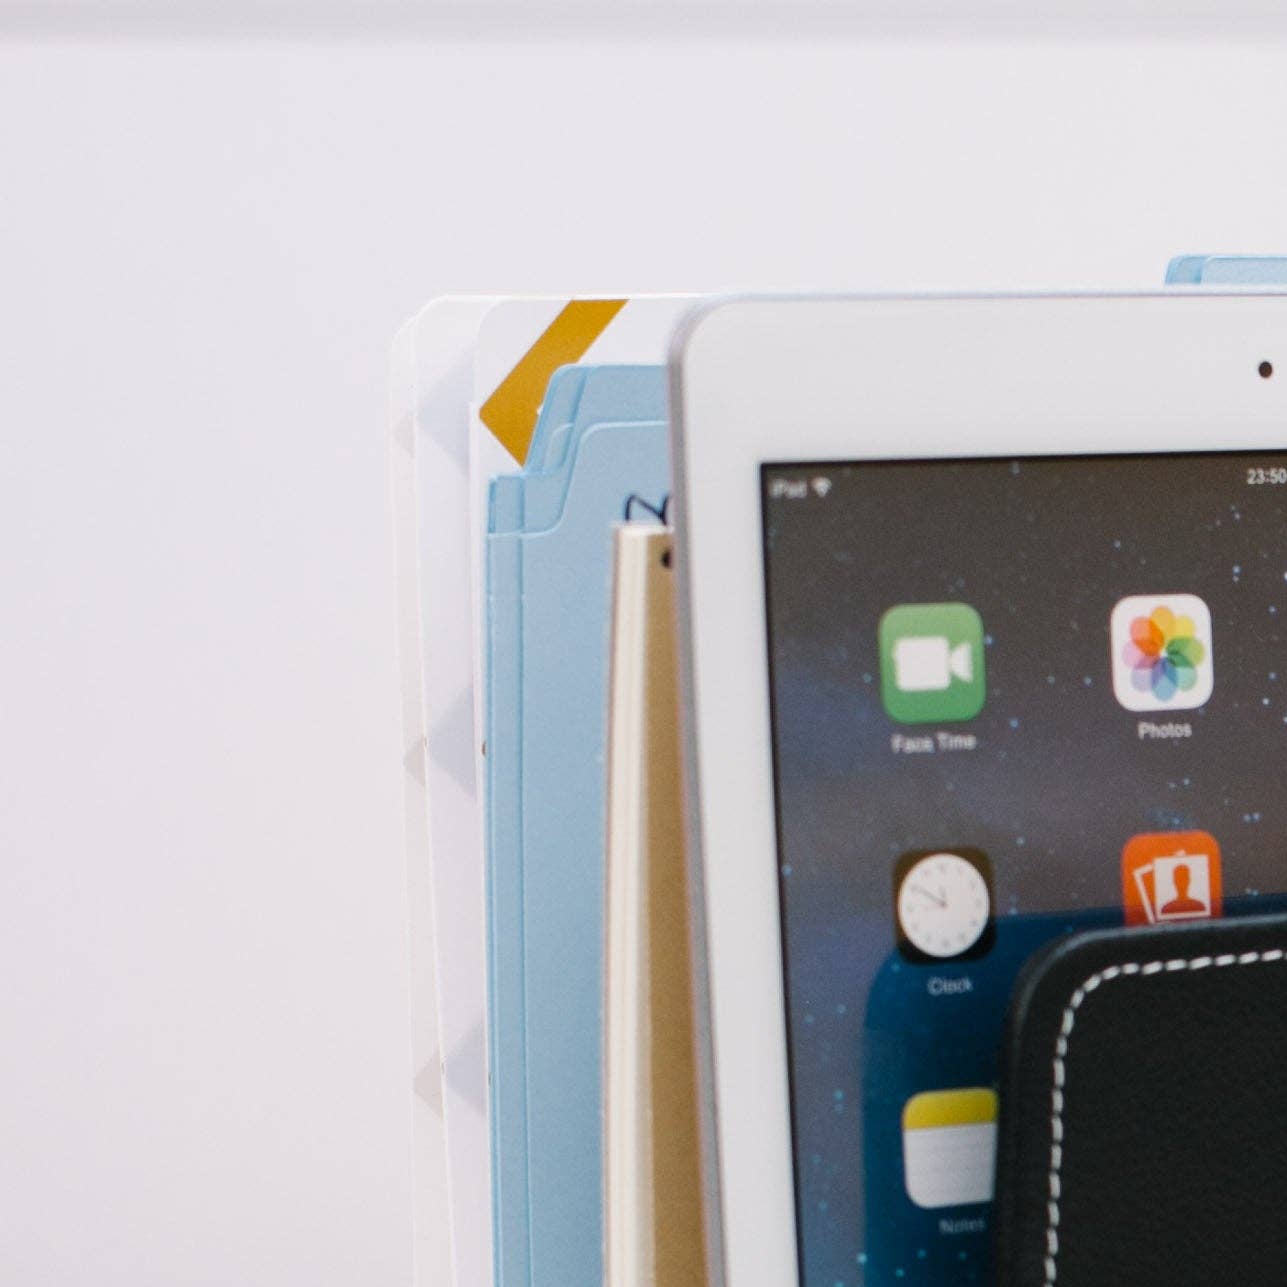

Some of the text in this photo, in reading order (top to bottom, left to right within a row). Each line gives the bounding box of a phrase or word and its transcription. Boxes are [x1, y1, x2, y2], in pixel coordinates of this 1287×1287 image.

[1247, 467, 1287, 484] 23:50
[1139, 722, 1192, 739] Photos
[928, 976, 973, 996] Clock
